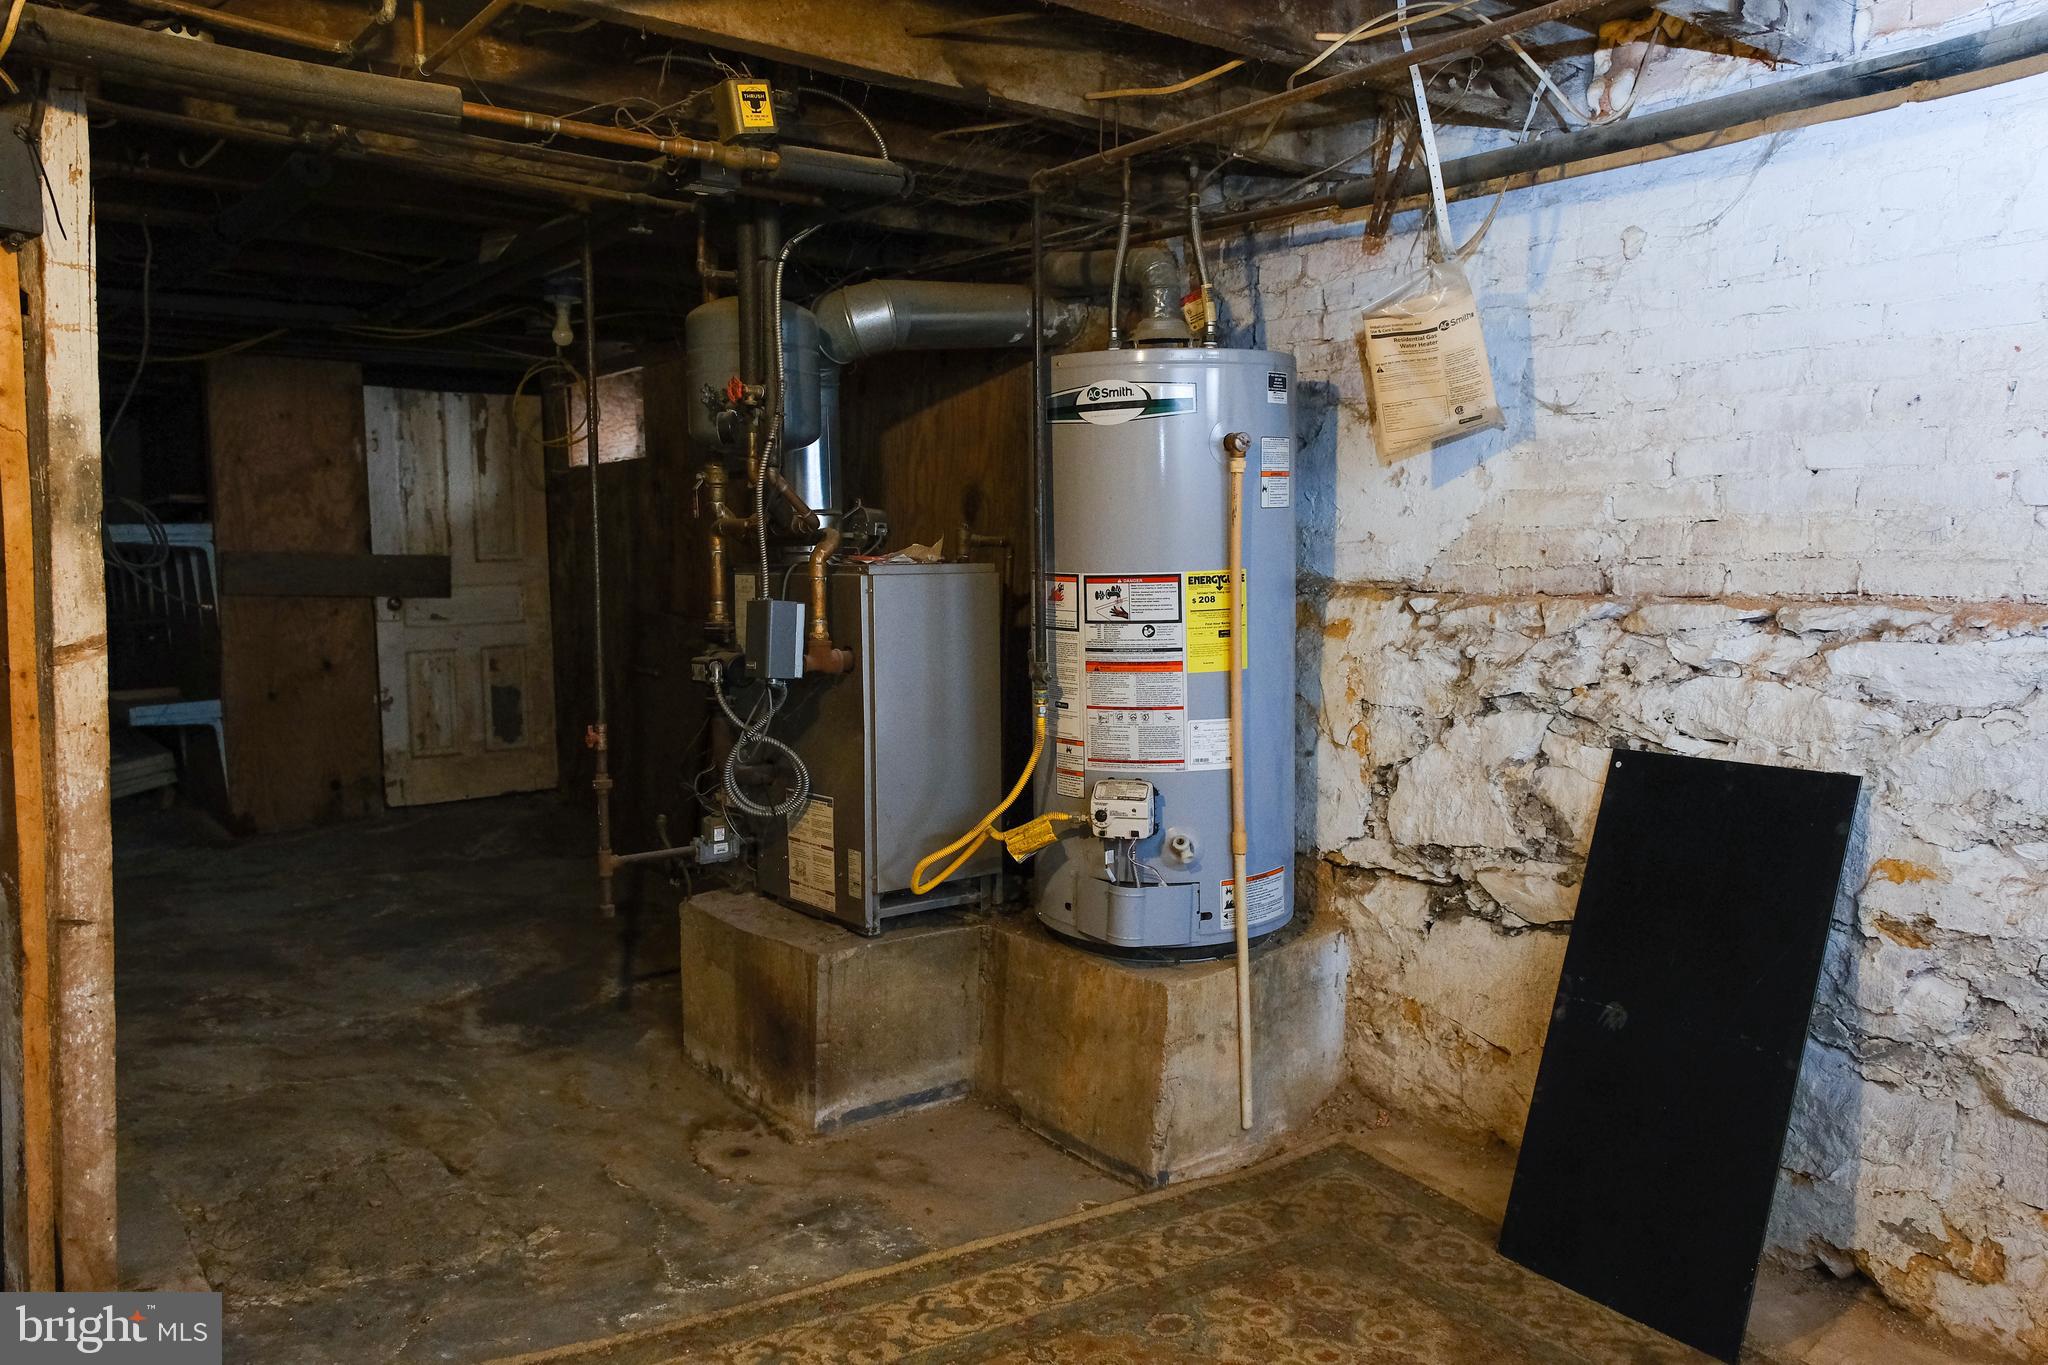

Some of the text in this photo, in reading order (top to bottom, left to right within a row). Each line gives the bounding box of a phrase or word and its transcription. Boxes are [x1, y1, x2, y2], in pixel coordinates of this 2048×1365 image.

[1393, 333, 1438, 343] Residential Gas
[1400, 341, 1417, 349] Water
[1101, 386, 1133, 398] Smith
[1199, 595, 1215, 604] 208
